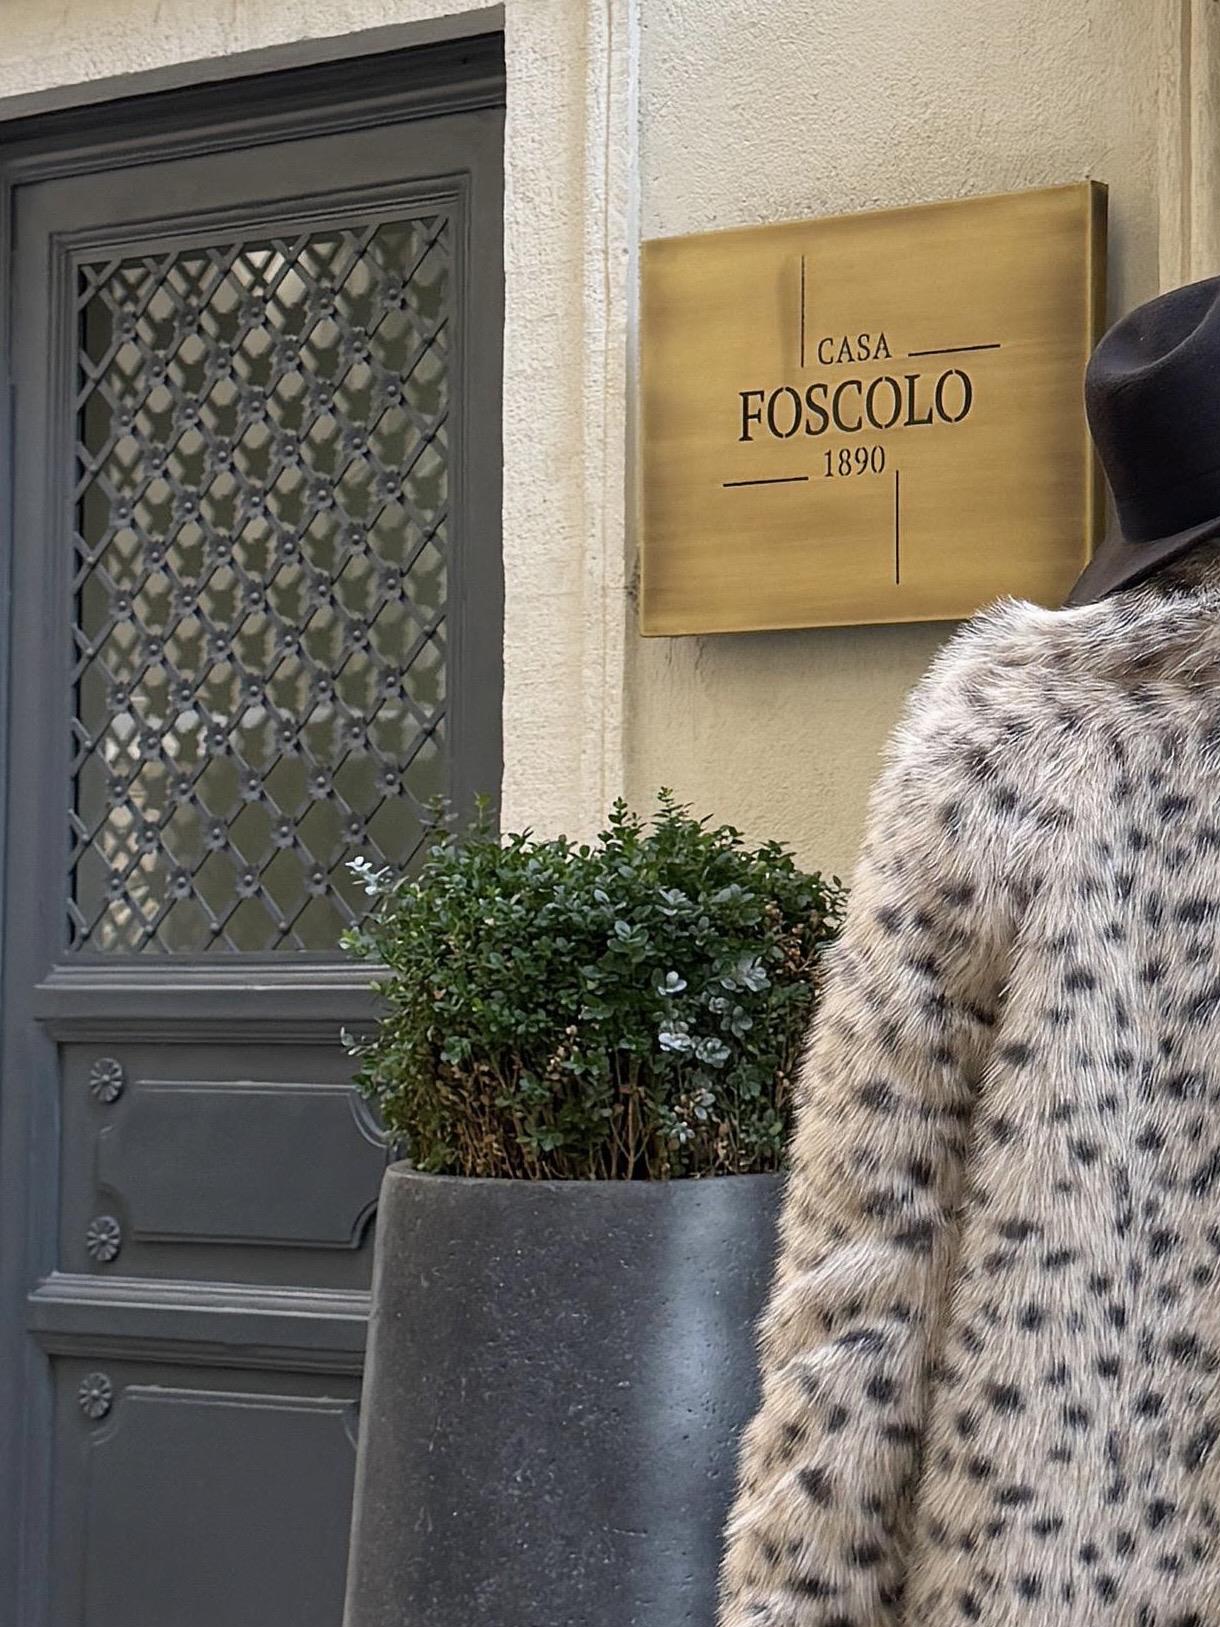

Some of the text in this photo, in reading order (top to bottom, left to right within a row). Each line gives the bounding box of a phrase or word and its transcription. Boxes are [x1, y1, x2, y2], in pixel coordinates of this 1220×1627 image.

[817, 332, 893, 365] CASA
[738, 369, 974, 442] FOSCOLO
[824, 445, 886, 477] 1890
